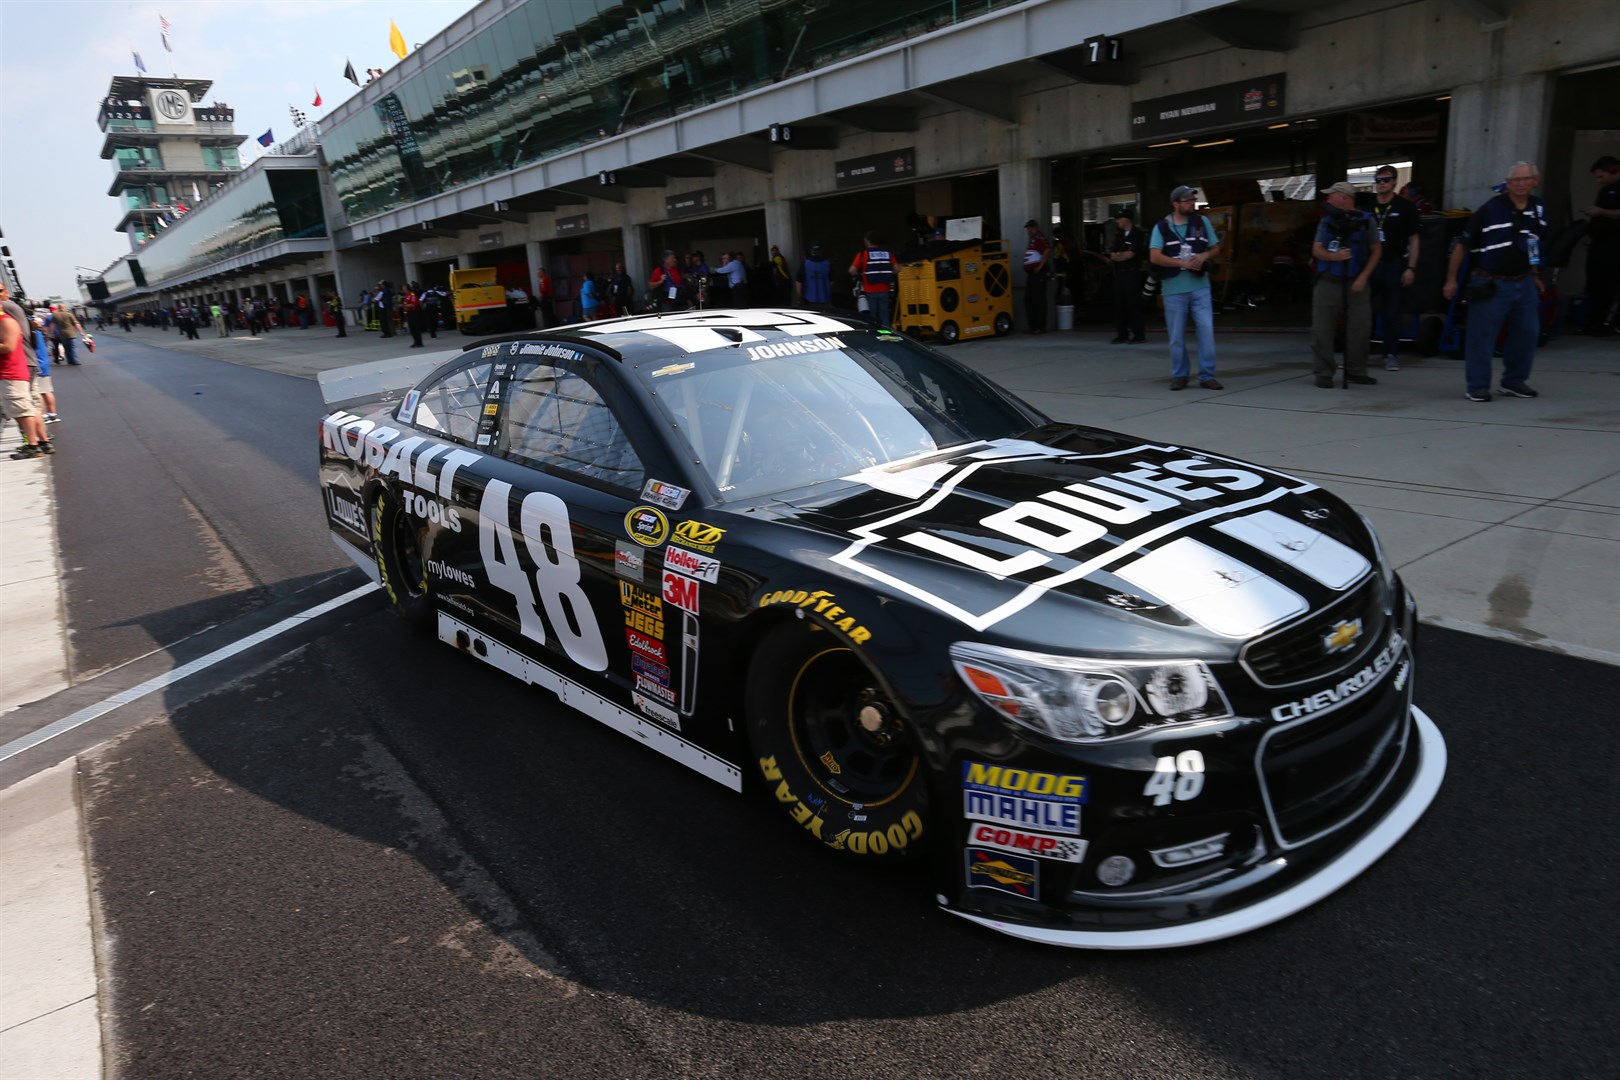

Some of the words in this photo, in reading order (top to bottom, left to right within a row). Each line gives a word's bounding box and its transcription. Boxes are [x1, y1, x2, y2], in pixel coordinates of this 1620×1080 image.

[1089, 41, 1099, 62] 7
[1110, 40, 1119, 59] 7
[161, 95, 184, 115] IMS
[1160, 109, 1180, 120] RYAN
[1181, 102, 1216, 117] NEWMAN
[771, 128, 777, 141] 8
[783, 127, 790, 141] 8
[543, 344, 575, 360] Johnson
[746, 337, 847, 361] JOHNSON
[322, 411, 483, 500] KOBALT
[402, 490, 462, 533] TOOLS
[427, 559, 476, 589] mylowes
[479, 478, 609, 672] 48
[666, 546, 699, 575] Holley
[631, 595, 661, 615] Meter
[632, 586, 656, 603] Auto
[664, 573, 699, 613] 3M
[625, 610, 665, 640] JEGS
[759, 590, 872, 645] GOODYEAR
[629, 634, 664, 659] Edelbrock
[645, 706, 678, 728] freescale
[965, 763, 1087, 798] MOOG
[1142, 749, 1206, 806] 48
[759, 755, 923, 855] GOODYEAR
[967, 791, 1077, 828] MAHLE
[975, 826, 1057, 851] COMP
